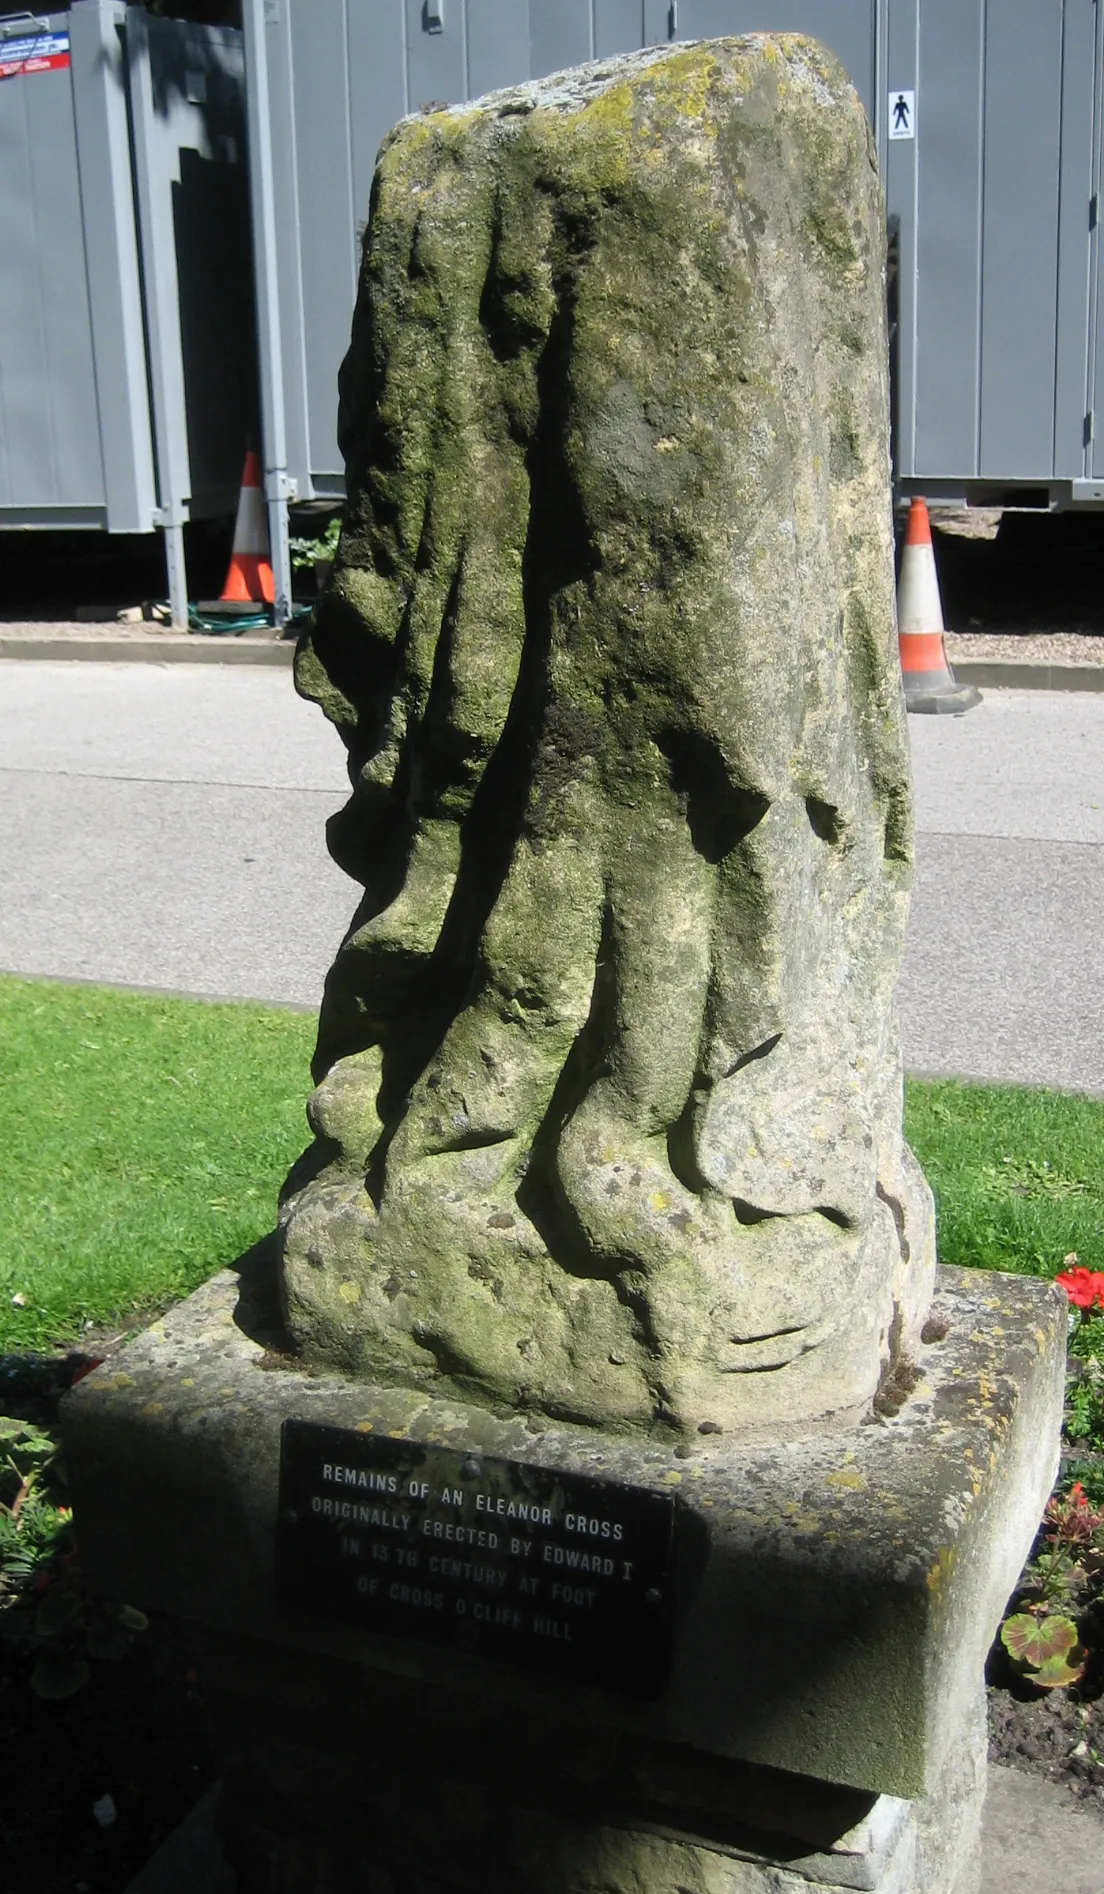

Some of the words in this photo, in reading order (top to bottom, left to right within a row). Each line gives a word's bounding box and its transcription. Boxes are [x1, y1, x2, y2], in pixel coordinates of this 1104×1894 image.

[312, 1497, 410, 1531] ORIGINALLY
[423, 1520, 498, 1549] ERECTED
[511, 1539, 531, 1556] BY
[544, 1545, 613, 1576] EDWARD
[623, 1562, 633, 1580] I
[323, 1464, 397, 1492] REMAINS
[409, 1482, 429, 1498] OF
[442, 1487, 463, 1506] AN
[476, 1494, 551, 1525] ELEANOR
[565, 1513, 623, 1540] CROSS
[343, 1537, 360, 1556] IN
[429, 1557, 508, 1587] CENTURY
[519, 1576, 539, 1595] AT
[552, 1585, 597, 1608] FOOT
[358, 1577, 380, 1595] OF
[390, 1585, 444, 1609] CROSS
[534, 1616, 573, 1641] HILL
